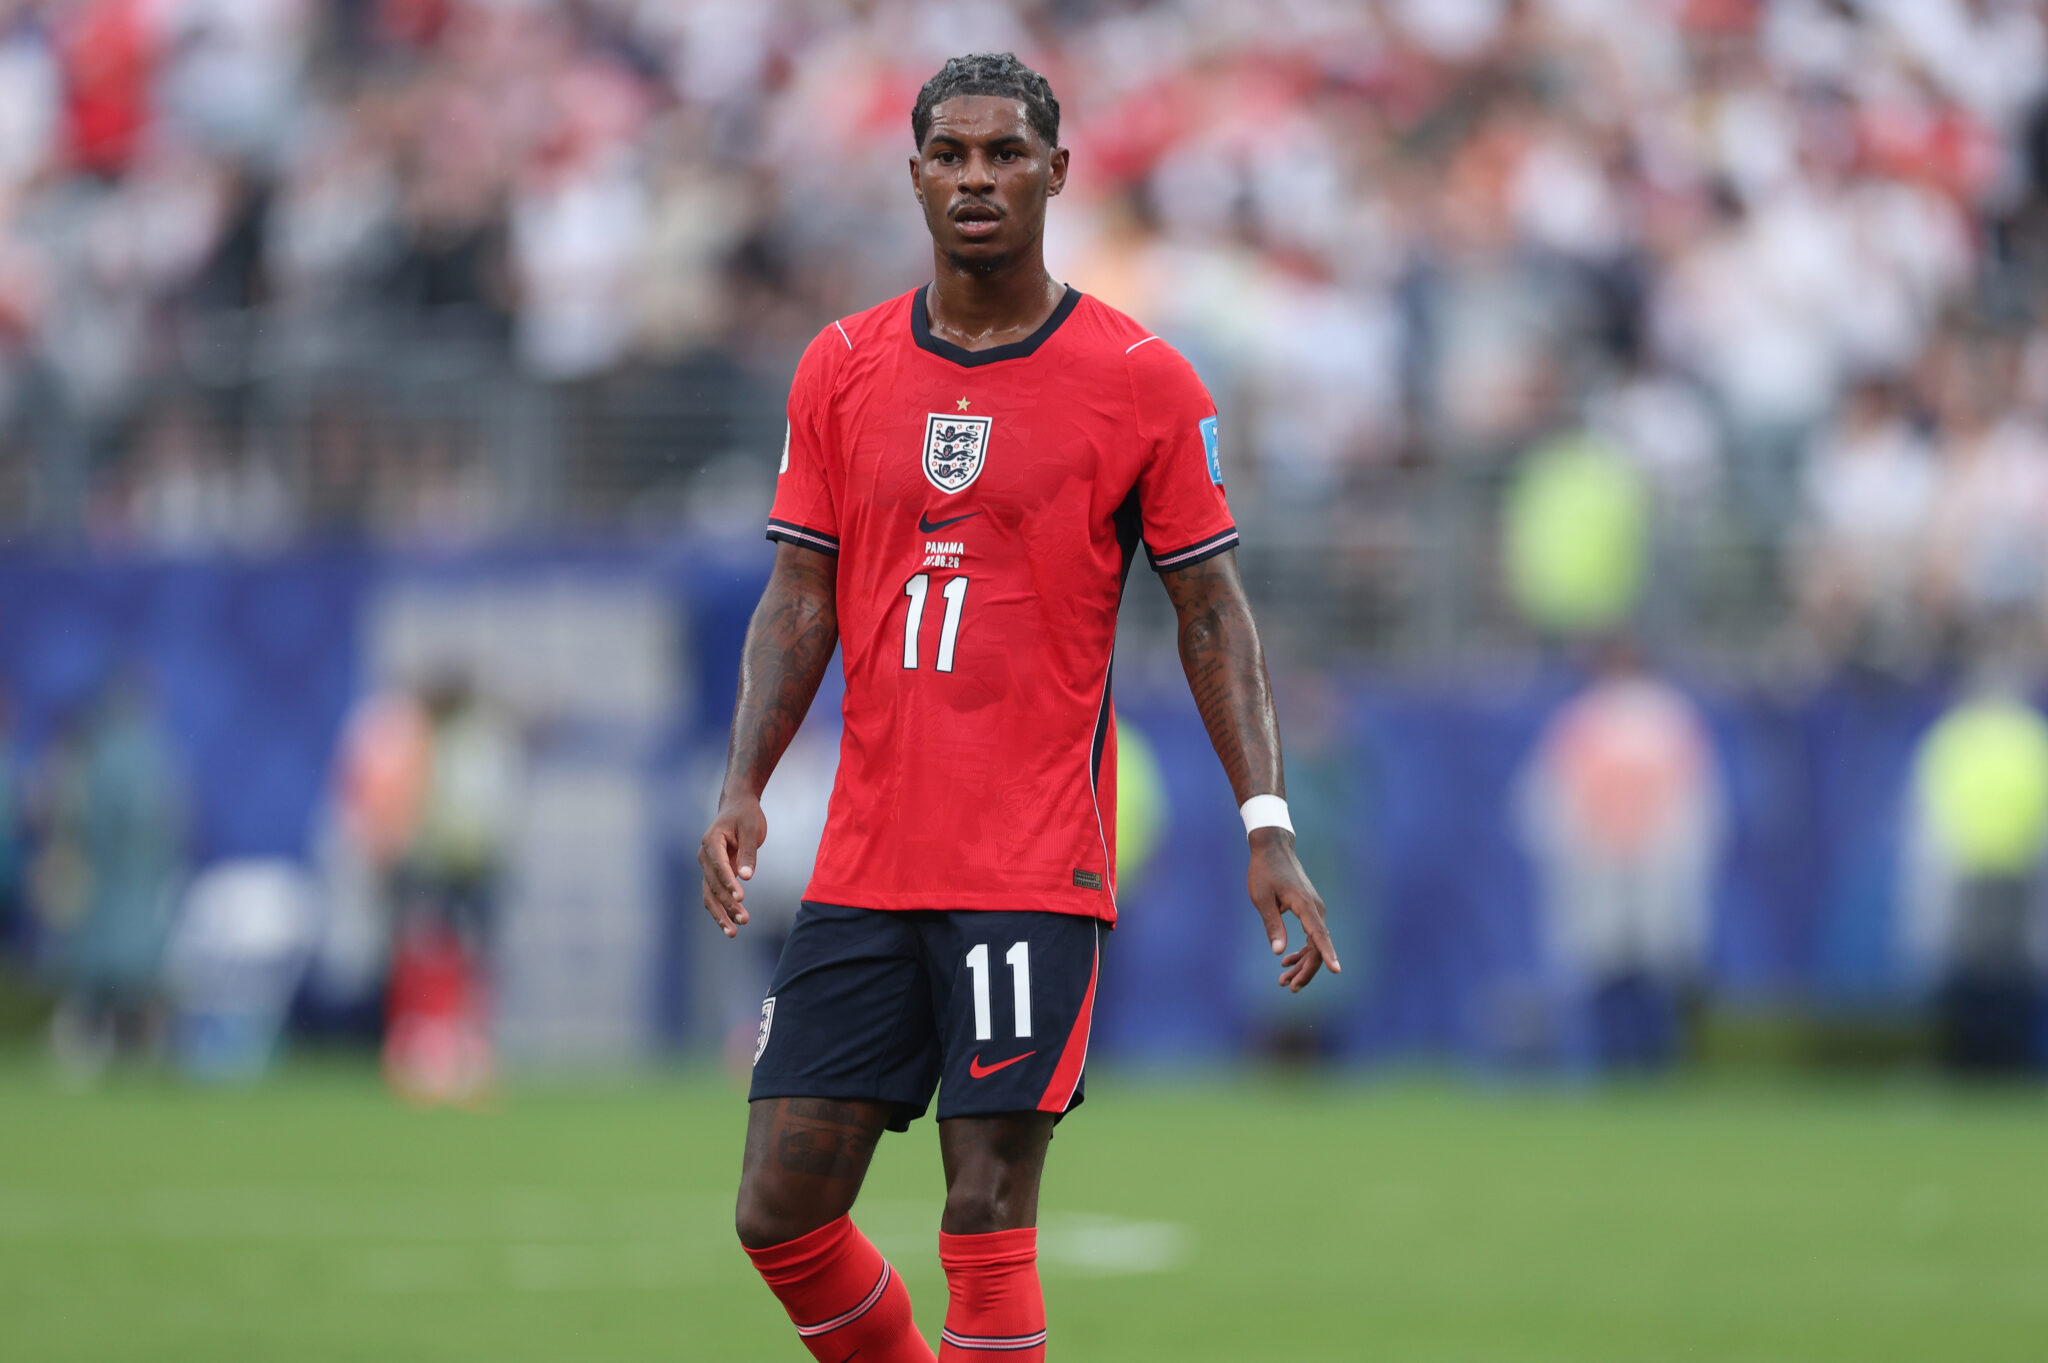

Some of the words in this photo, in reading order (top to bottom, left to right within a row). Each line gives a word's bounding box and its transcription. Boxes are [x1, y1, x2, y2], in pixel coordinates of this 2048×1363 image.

[925, 541, 964, 555] PANAMA
[903, 573, 969, 673] 11
[966, 941, 1031, 1040] 11
